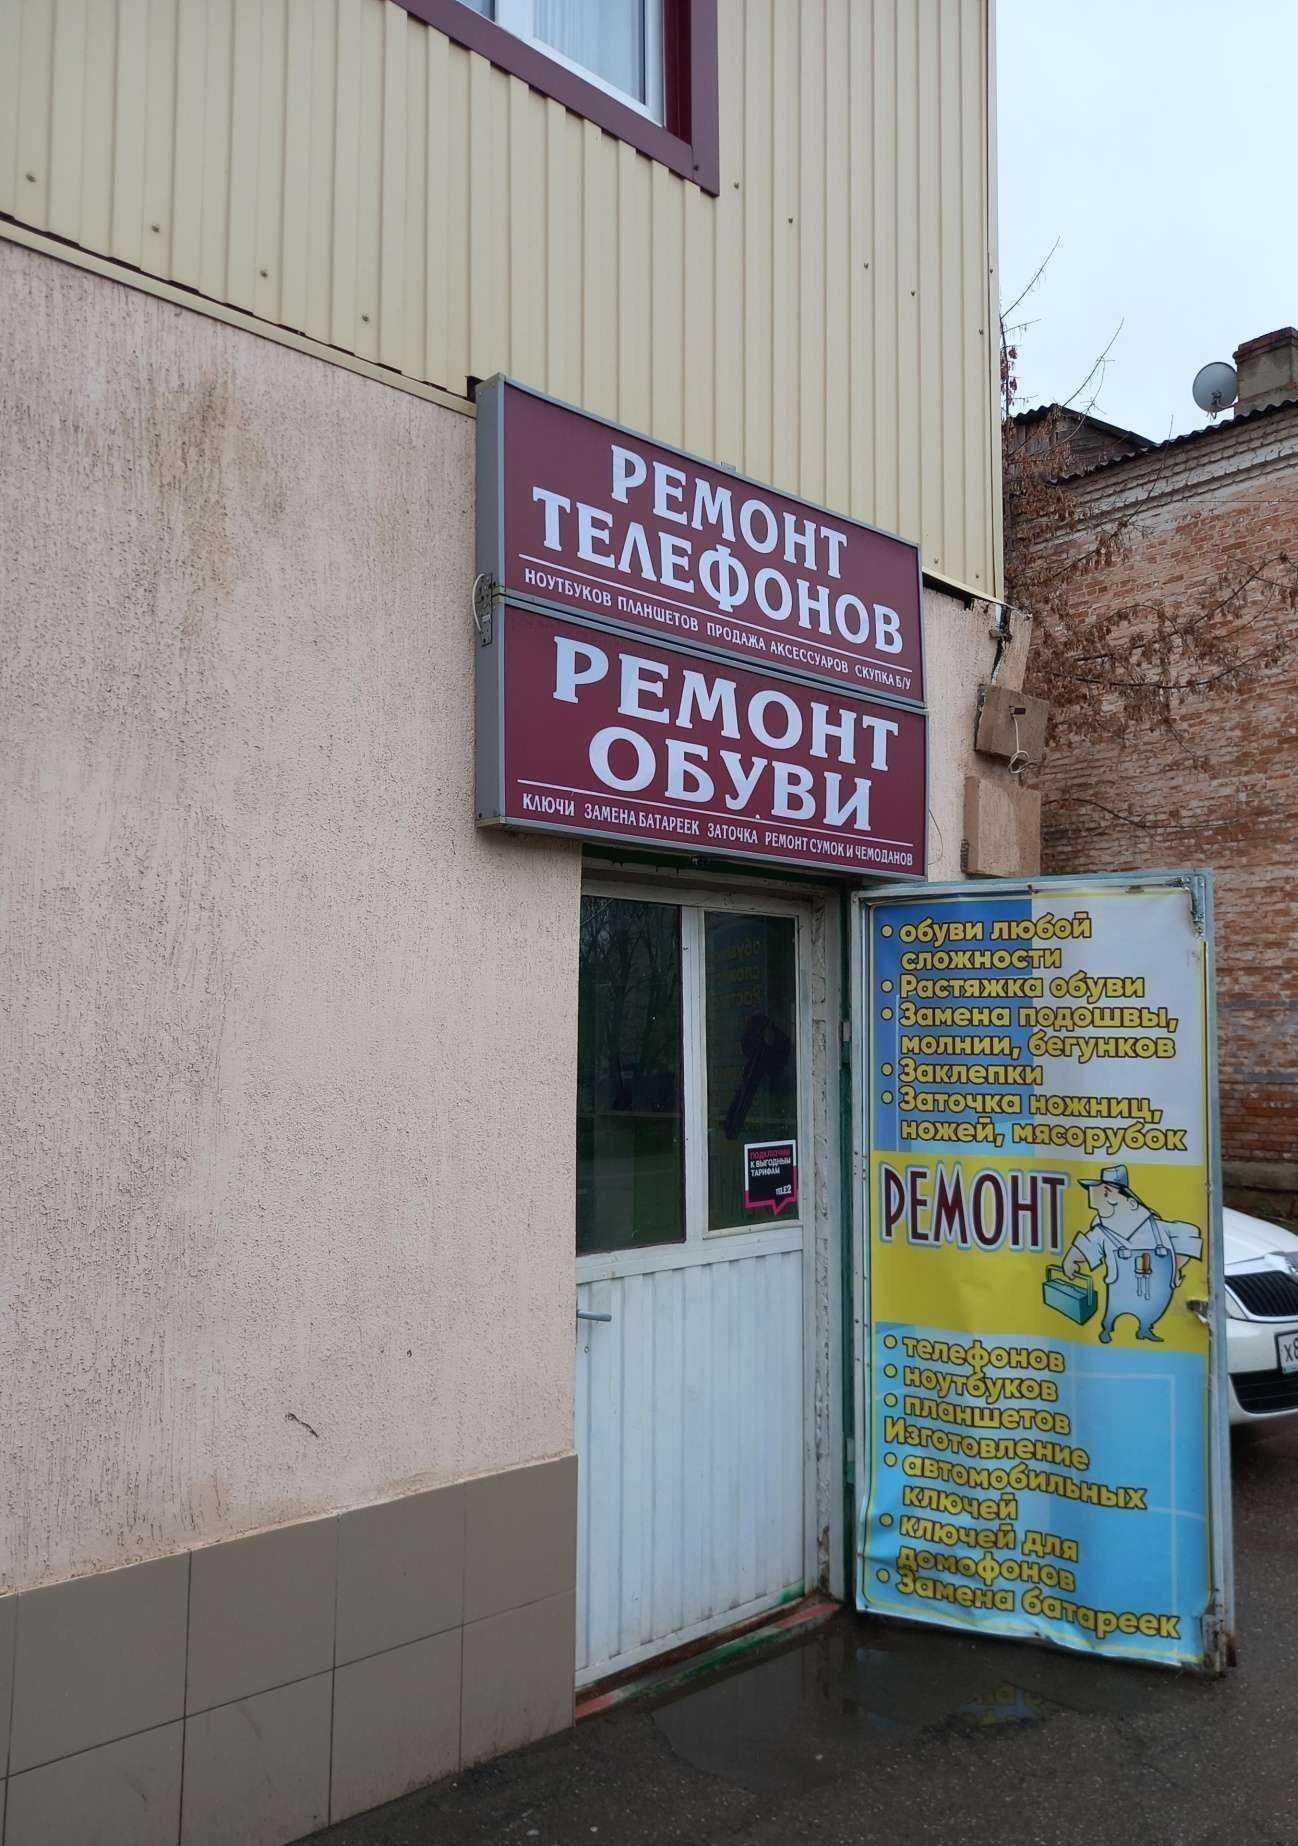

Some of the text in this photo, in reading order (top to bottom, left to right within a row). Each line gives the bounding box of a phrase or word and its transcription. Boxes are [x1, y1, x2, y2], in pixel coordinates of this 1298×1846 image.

[610, 444, 848, 579] РЕМОНТ
[532, 486, 904, 655] ТЕЛЕФОНОВ
[524, 568, 913, 690] НОУТБУКОВ ПЛАНШЕТОВ ПРОДАЖА АКСЕССУАРОВ СКУПКА Б/У
[552, 635, 899, 771] РЕМОНТ
[588, 725, 872, 831] ОБУВИ
[522, 793, 913, 866] КЛЮЧИ ЗАМЕНА БАТАРЕЕК ЗАТОЧКА РЕМОНТ СУМОК И ЧЕМОДАНОВ
[899, 911, 1092, 947] обуви любой
[901, 947, 1062, 971] сложности
[900, 970, 1145, 1005] Растяжка обуви
[899, 1001, 1179, 1032] Замена подошвы,
[901, 1030, 1176, 1063] молнии, бегунков
[899, 1057, 1044, 1086] Заклепки
[899, 1085, 1163, 1123] Заточка ножниц,
[901, 1116, 1189, 1154] ножей, мясорубок
[750, 1167, 780, 1177] ТАРИФАМ
[755, 1156, 791, 1168] ВЫГОДНЫМ
[881, 1162, 1068, 1252] РЕМОНТ
[902, 1335, 1066, 1374] телефонов
[903, 1365, 1058, 1404] ноутбуков
[904, 1395, 1071, 1435] планшетов
[884, 1416, 1090, 1471] Изготовление
[902, 1454, 1148, 1510] автомобильных
[902, 1485, 1018, 1521] ключей
[900, 1515, 1079, 1562] ключей для
[897, 1546, 1076, 1592] домофонов
[896, 1567, 1181, 1640] Замена батареек
